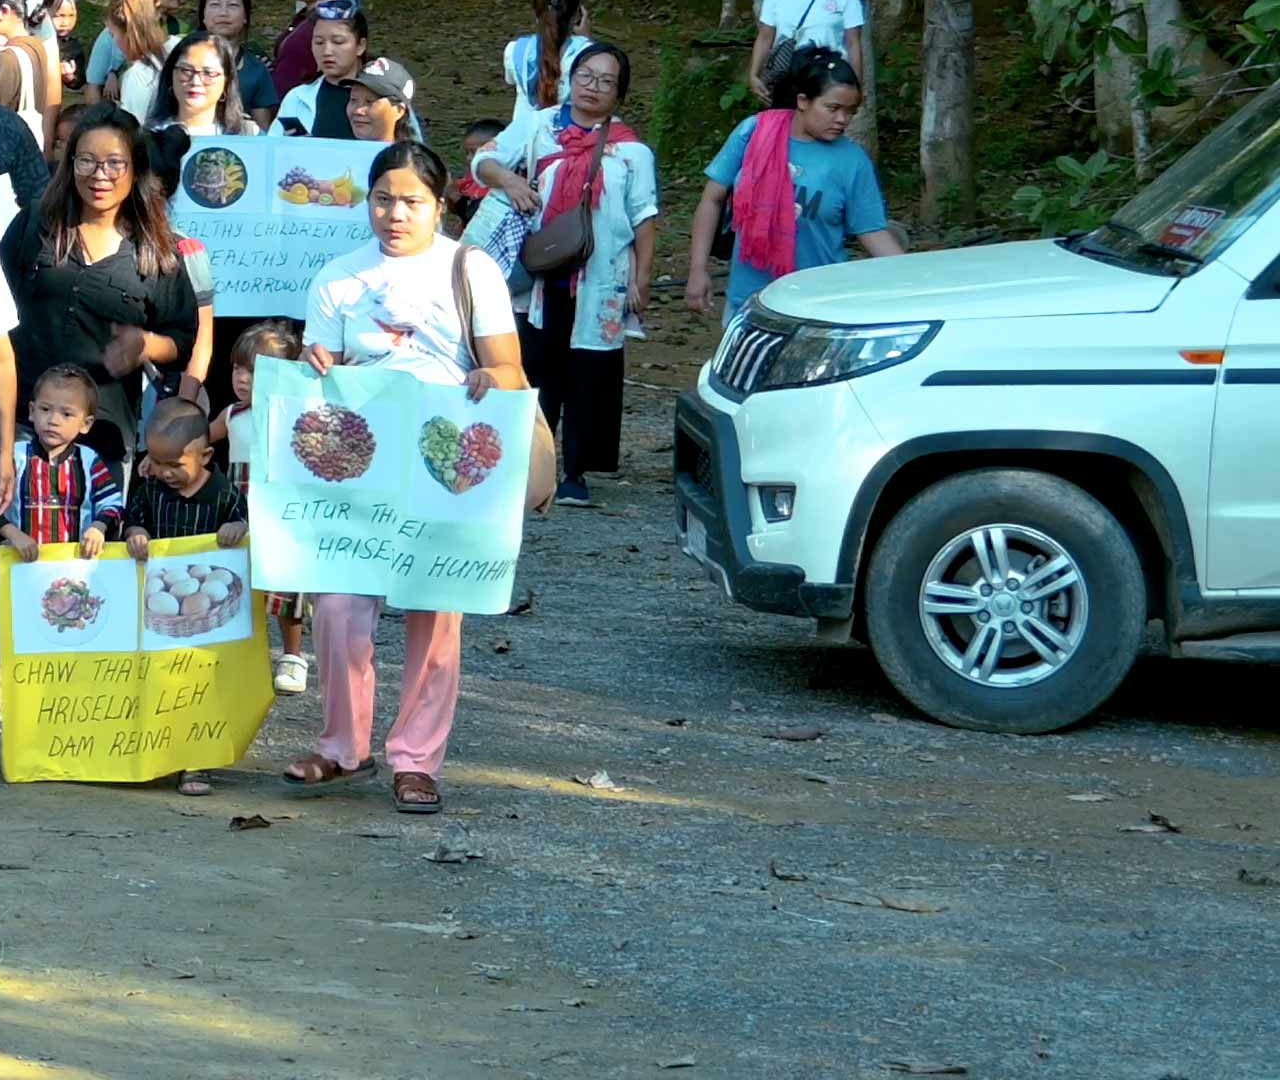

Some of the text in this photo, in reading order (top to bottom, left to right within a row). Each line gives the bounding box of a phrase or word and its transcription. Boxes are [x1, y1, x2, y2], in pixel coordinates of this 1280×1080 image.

[177, 220, 373, 240] EALTHY CHILDREN TOD
[210, 250, 289, 266] EALTHY
[212, 276, 312, 294] OMORROW!!
[282, 499, 352, 520] EITUR
[13, 659, 78, 684] CHAW
[155, 682, 209, 715] LEH
[48, 736, 94, 758] DAM
[186, 721, 227, 742] ANI
